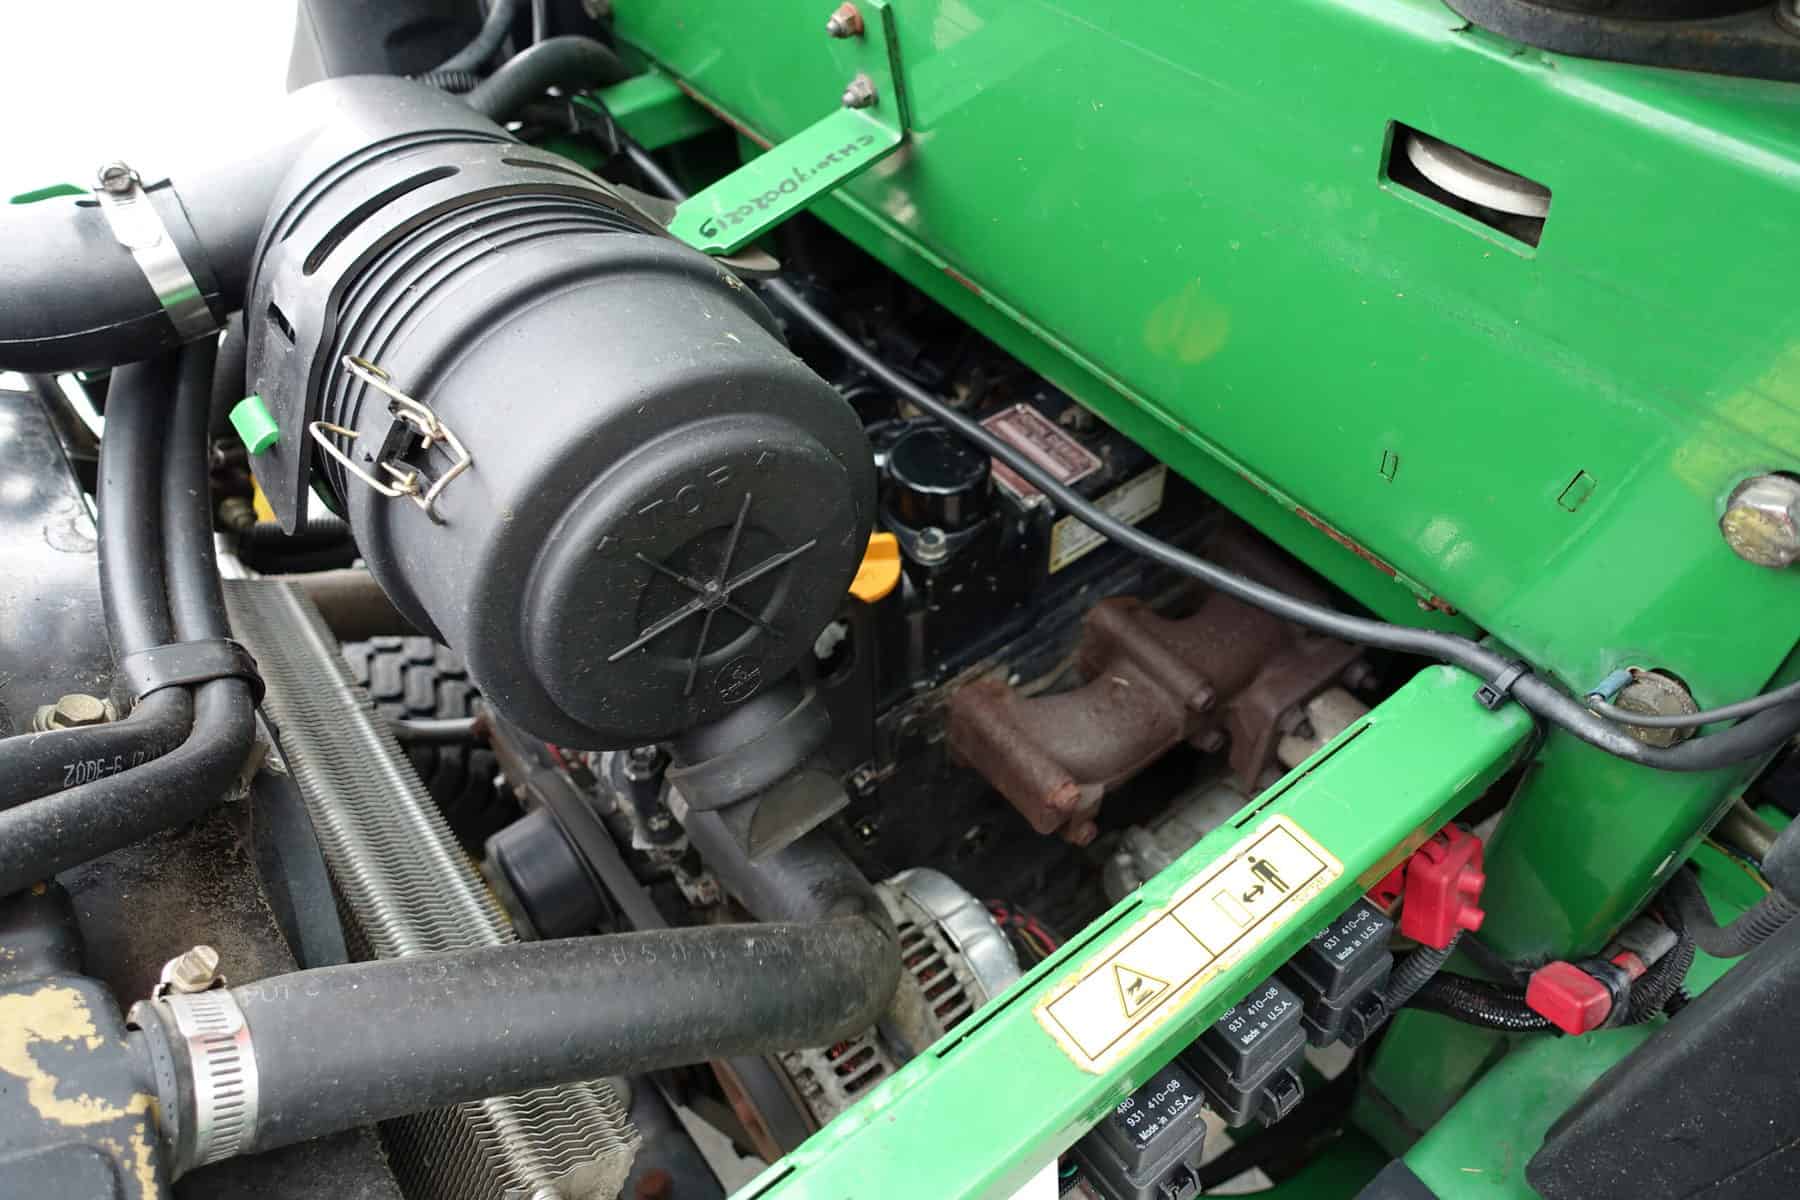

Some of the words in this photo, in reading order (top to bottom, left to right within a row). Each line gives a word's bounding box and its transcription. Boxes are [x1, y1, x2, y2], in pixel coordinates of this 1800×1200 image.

[1323, 935, 1341, 950] 931
[1341, 909, 1370, 935] 410-08
[1228, 1016, 1246, 1033] 931
[1247, 986, 1279, 1016] 410-08
[1241, 1028, 1260, 1045] Made
[1258, 1021, 1269, 1029] in
[1126, 1110, 1145, 1127] 931
[1148, 1079, 1181, 1109] 410-08
[1138, 1122, 1159, 1141] Made
[1157, 1116, 1169, 1127] in
